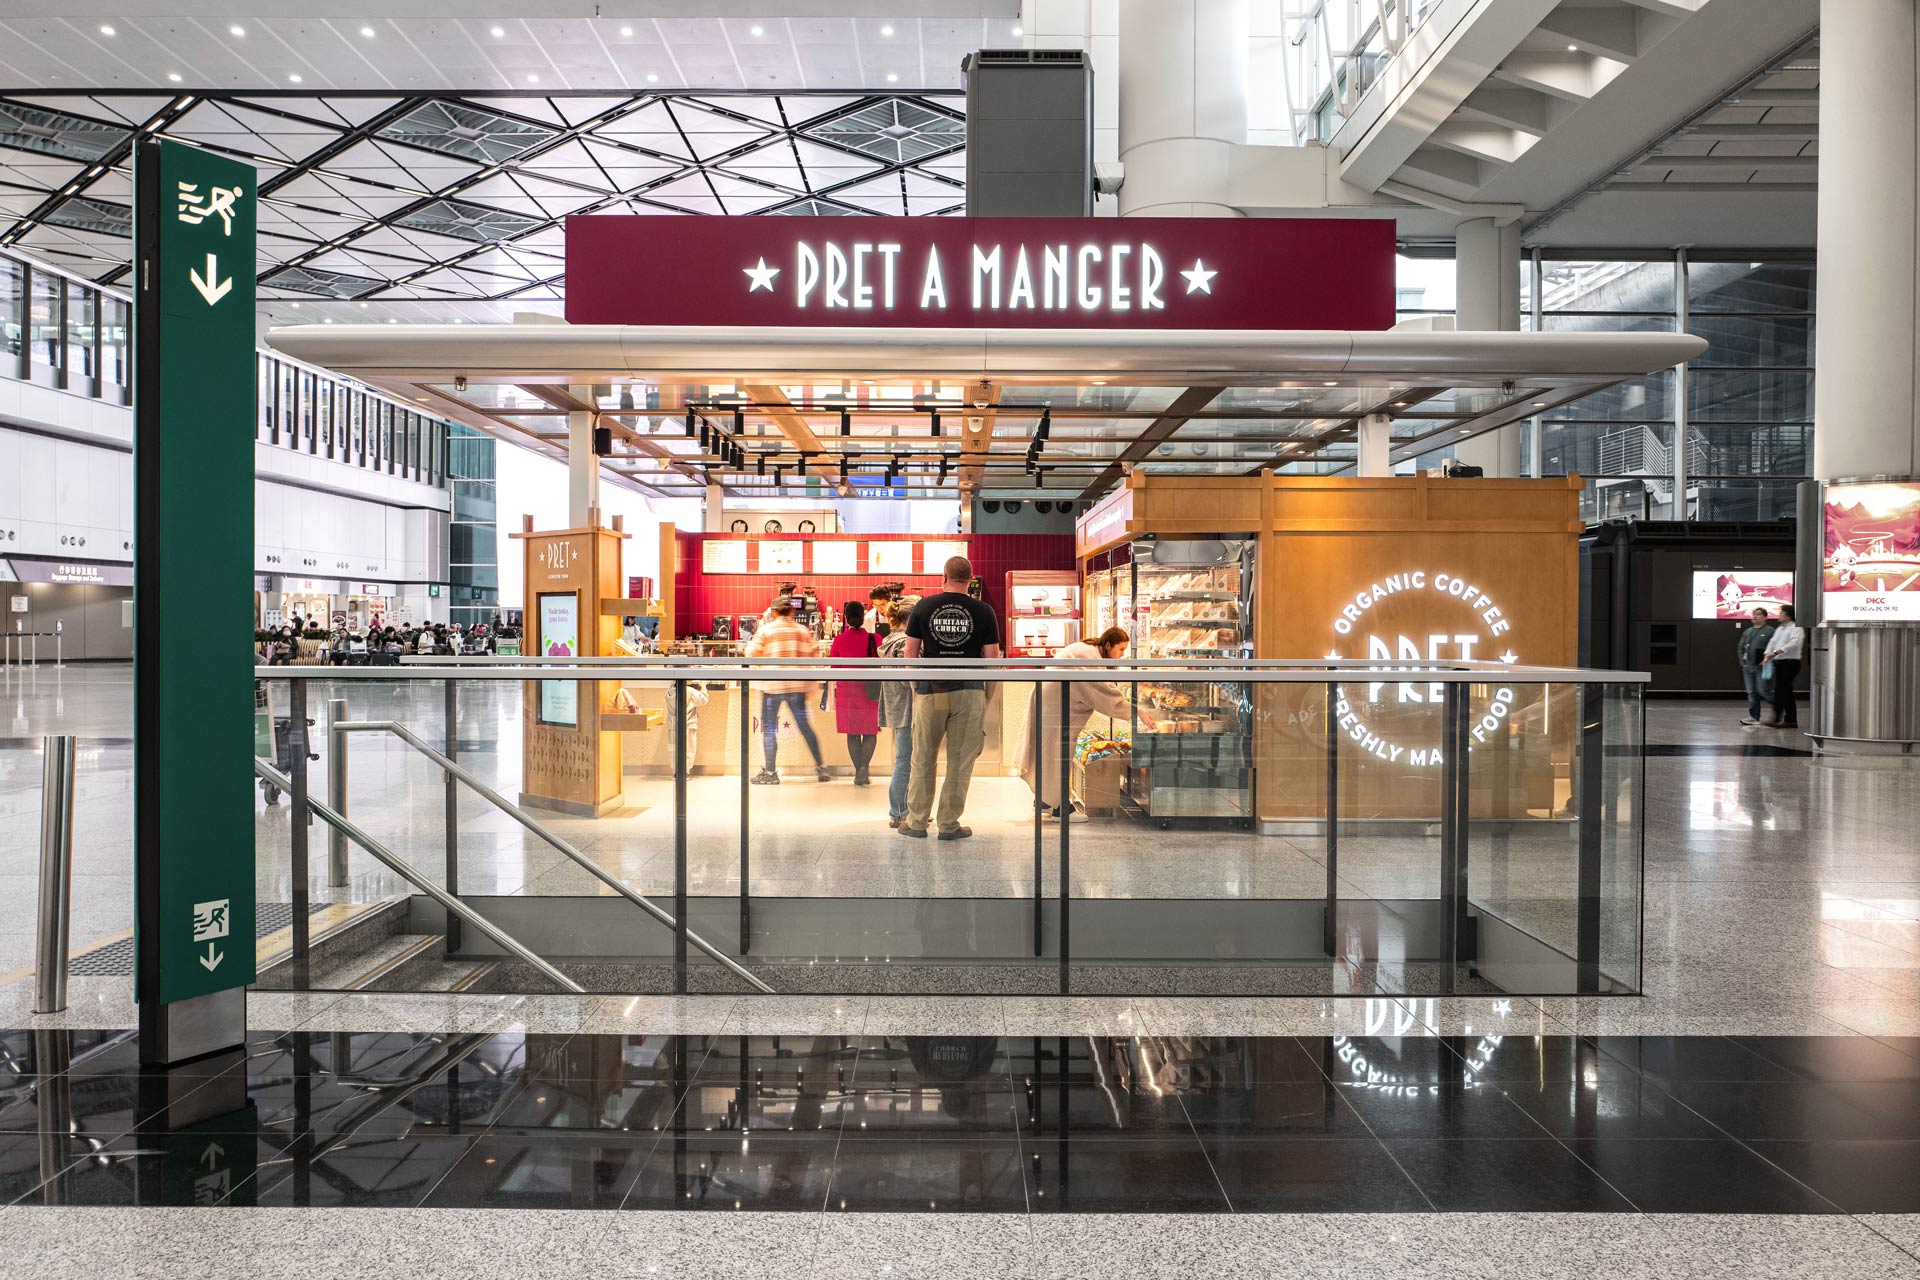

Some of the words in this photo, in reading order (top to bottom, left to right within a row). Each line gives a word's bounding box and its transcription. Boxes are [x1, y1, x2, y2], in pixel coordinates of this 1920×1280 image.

[797, 241, 901, 308] PRET
[920, 242, 947, 308] A
[972, 242, 1165, 309] MANGER
[547, 541, 570, 569] PRET
[933, 618, 970, 626] HERITAGE
[1334, 571, 1425, 635] ORGANIC
[1434, 574, 1510, 637] COFFEE
[1369, 635, 1479, 703] PRET
[1410, 748, 1444, 766] MA
[1471, 687, 1514, 743] FOOD
